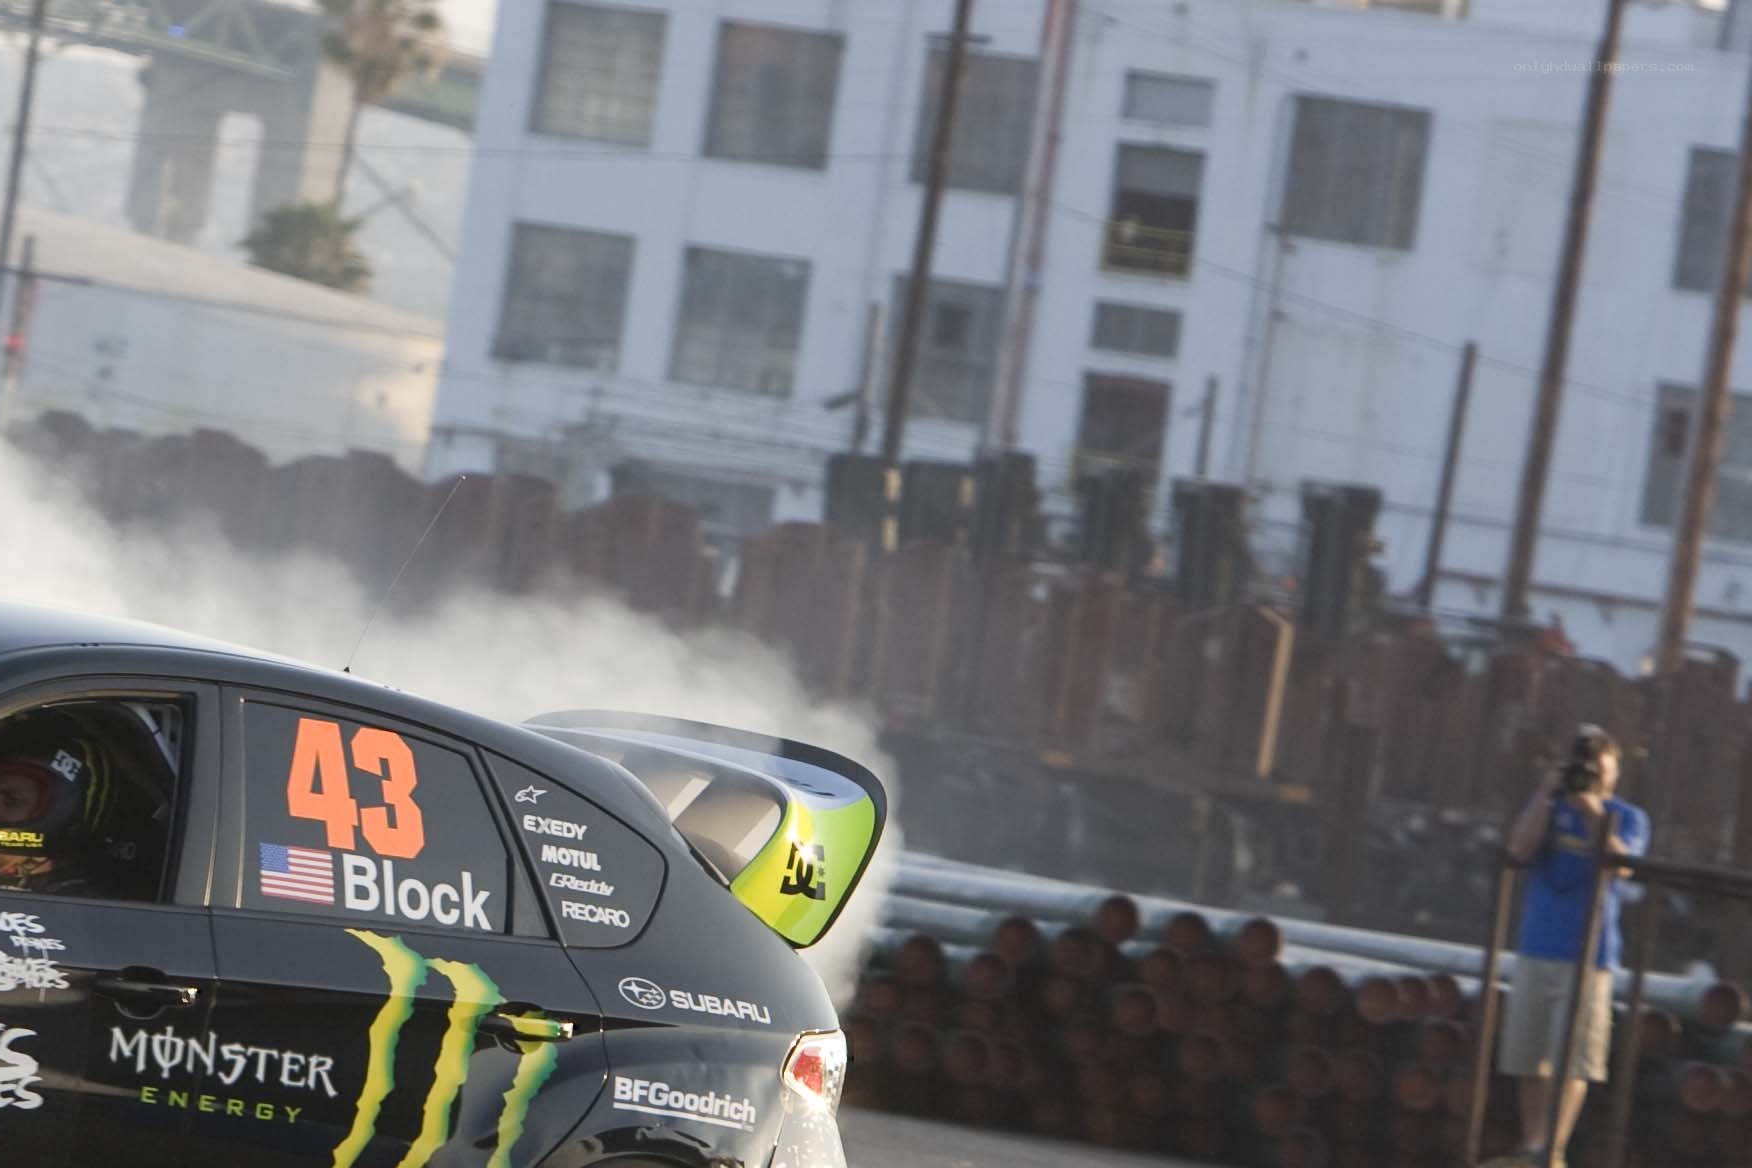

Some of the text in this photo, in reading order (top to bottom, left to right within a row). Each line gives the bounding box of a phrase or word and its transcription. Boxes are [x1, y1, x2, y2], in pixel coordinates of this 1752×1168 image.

[286, 717, 425, 860] 43
[522, 813, 588, 841] EXEDY
[540, 844, 602, 872] MOTUL
[341, 852, 493, 931] Block
[548, 871, 616, 897] GReddy
[560, 899, 631, 929] RECARO
[669, 989, 772, 1025] SUBARU
[109, 1025, 339, 1098] MONSTER
[140, 1086, 303, 1124] ENERGY
[613, 1075, 757, 1124] BFGoodrich
